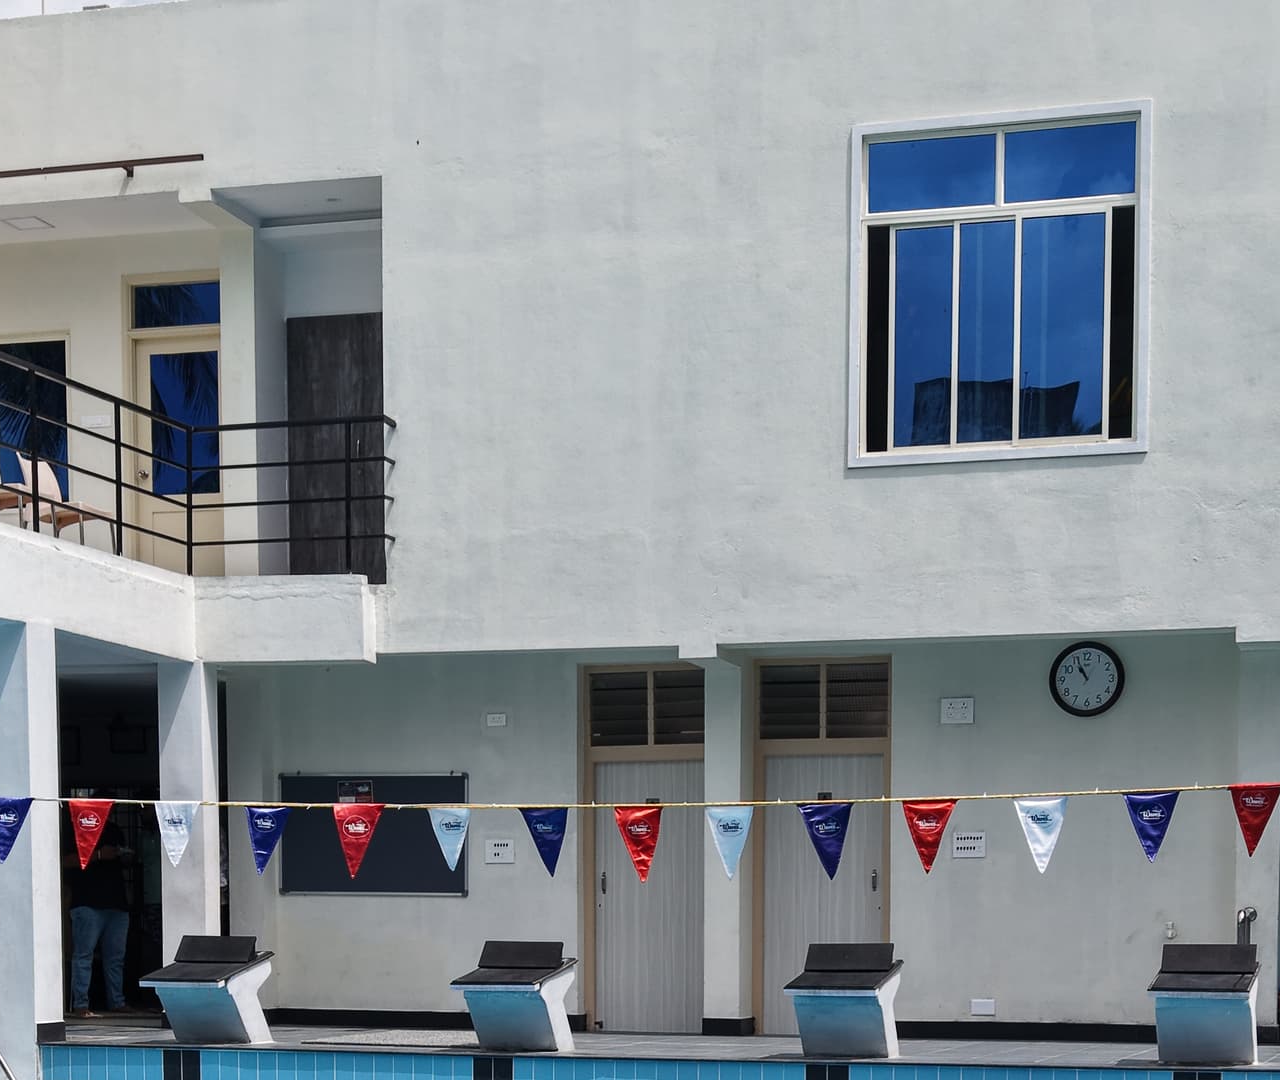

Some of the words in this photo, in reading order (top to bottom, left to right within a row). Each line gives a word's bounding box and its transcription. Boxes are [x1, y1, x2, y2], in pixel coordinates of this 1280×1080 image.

[1073, 656, 1080, 665] 11
[1083, 652, 1092, 661] 12
[1097, 654, 1101, 663] 1
[1065, 665, 1073, 674] 10
[1105, 662, 1111, 671] 2
[1060, 676, 1065, 685] 9
[1109, 674, 1114, 682] 3
[1064, 688, 1069, 696] 8
[1105, 686, 1110, 694] 4
[1072, 695, 1078, 705] 7
[1084, 697, 1090, 706] 6
[1096, 695, 1102, 703] 5
